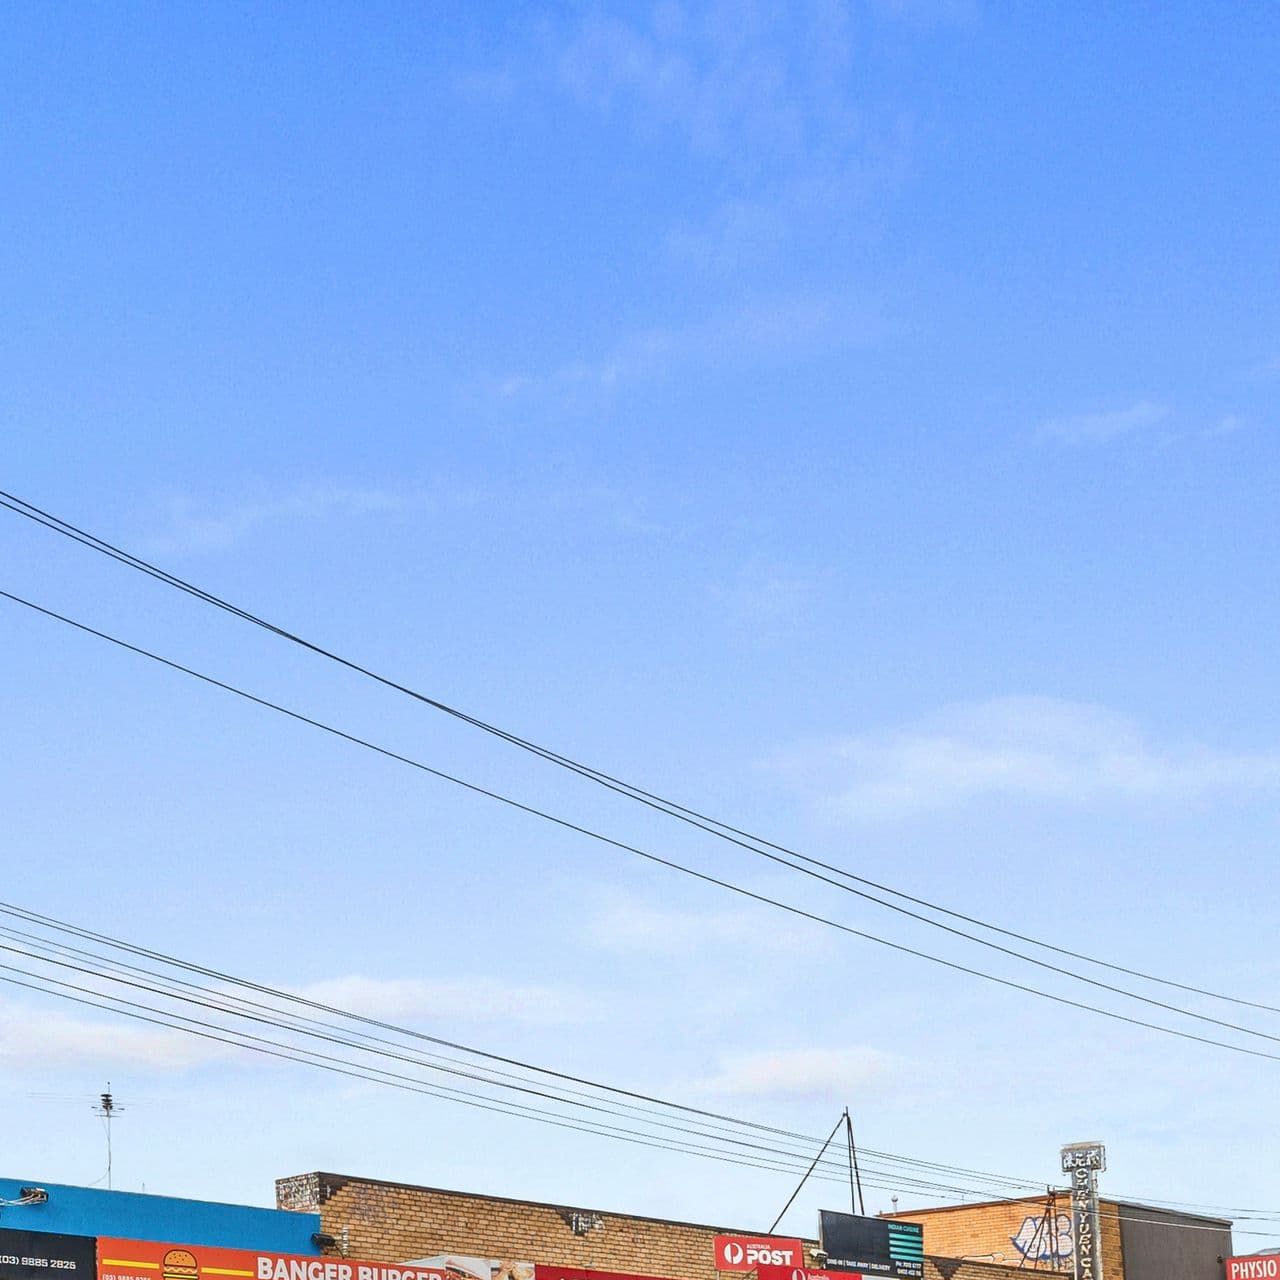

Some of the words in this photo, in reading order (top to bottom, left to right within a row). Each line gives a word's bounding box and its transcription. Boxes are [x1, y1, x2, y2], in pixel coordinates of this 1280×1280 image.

[21, 1256, 48, 1268] 9885
[746, 1250, 794, 1266] POST
[1231, 1259, 1278, 1280] PHYSIO
